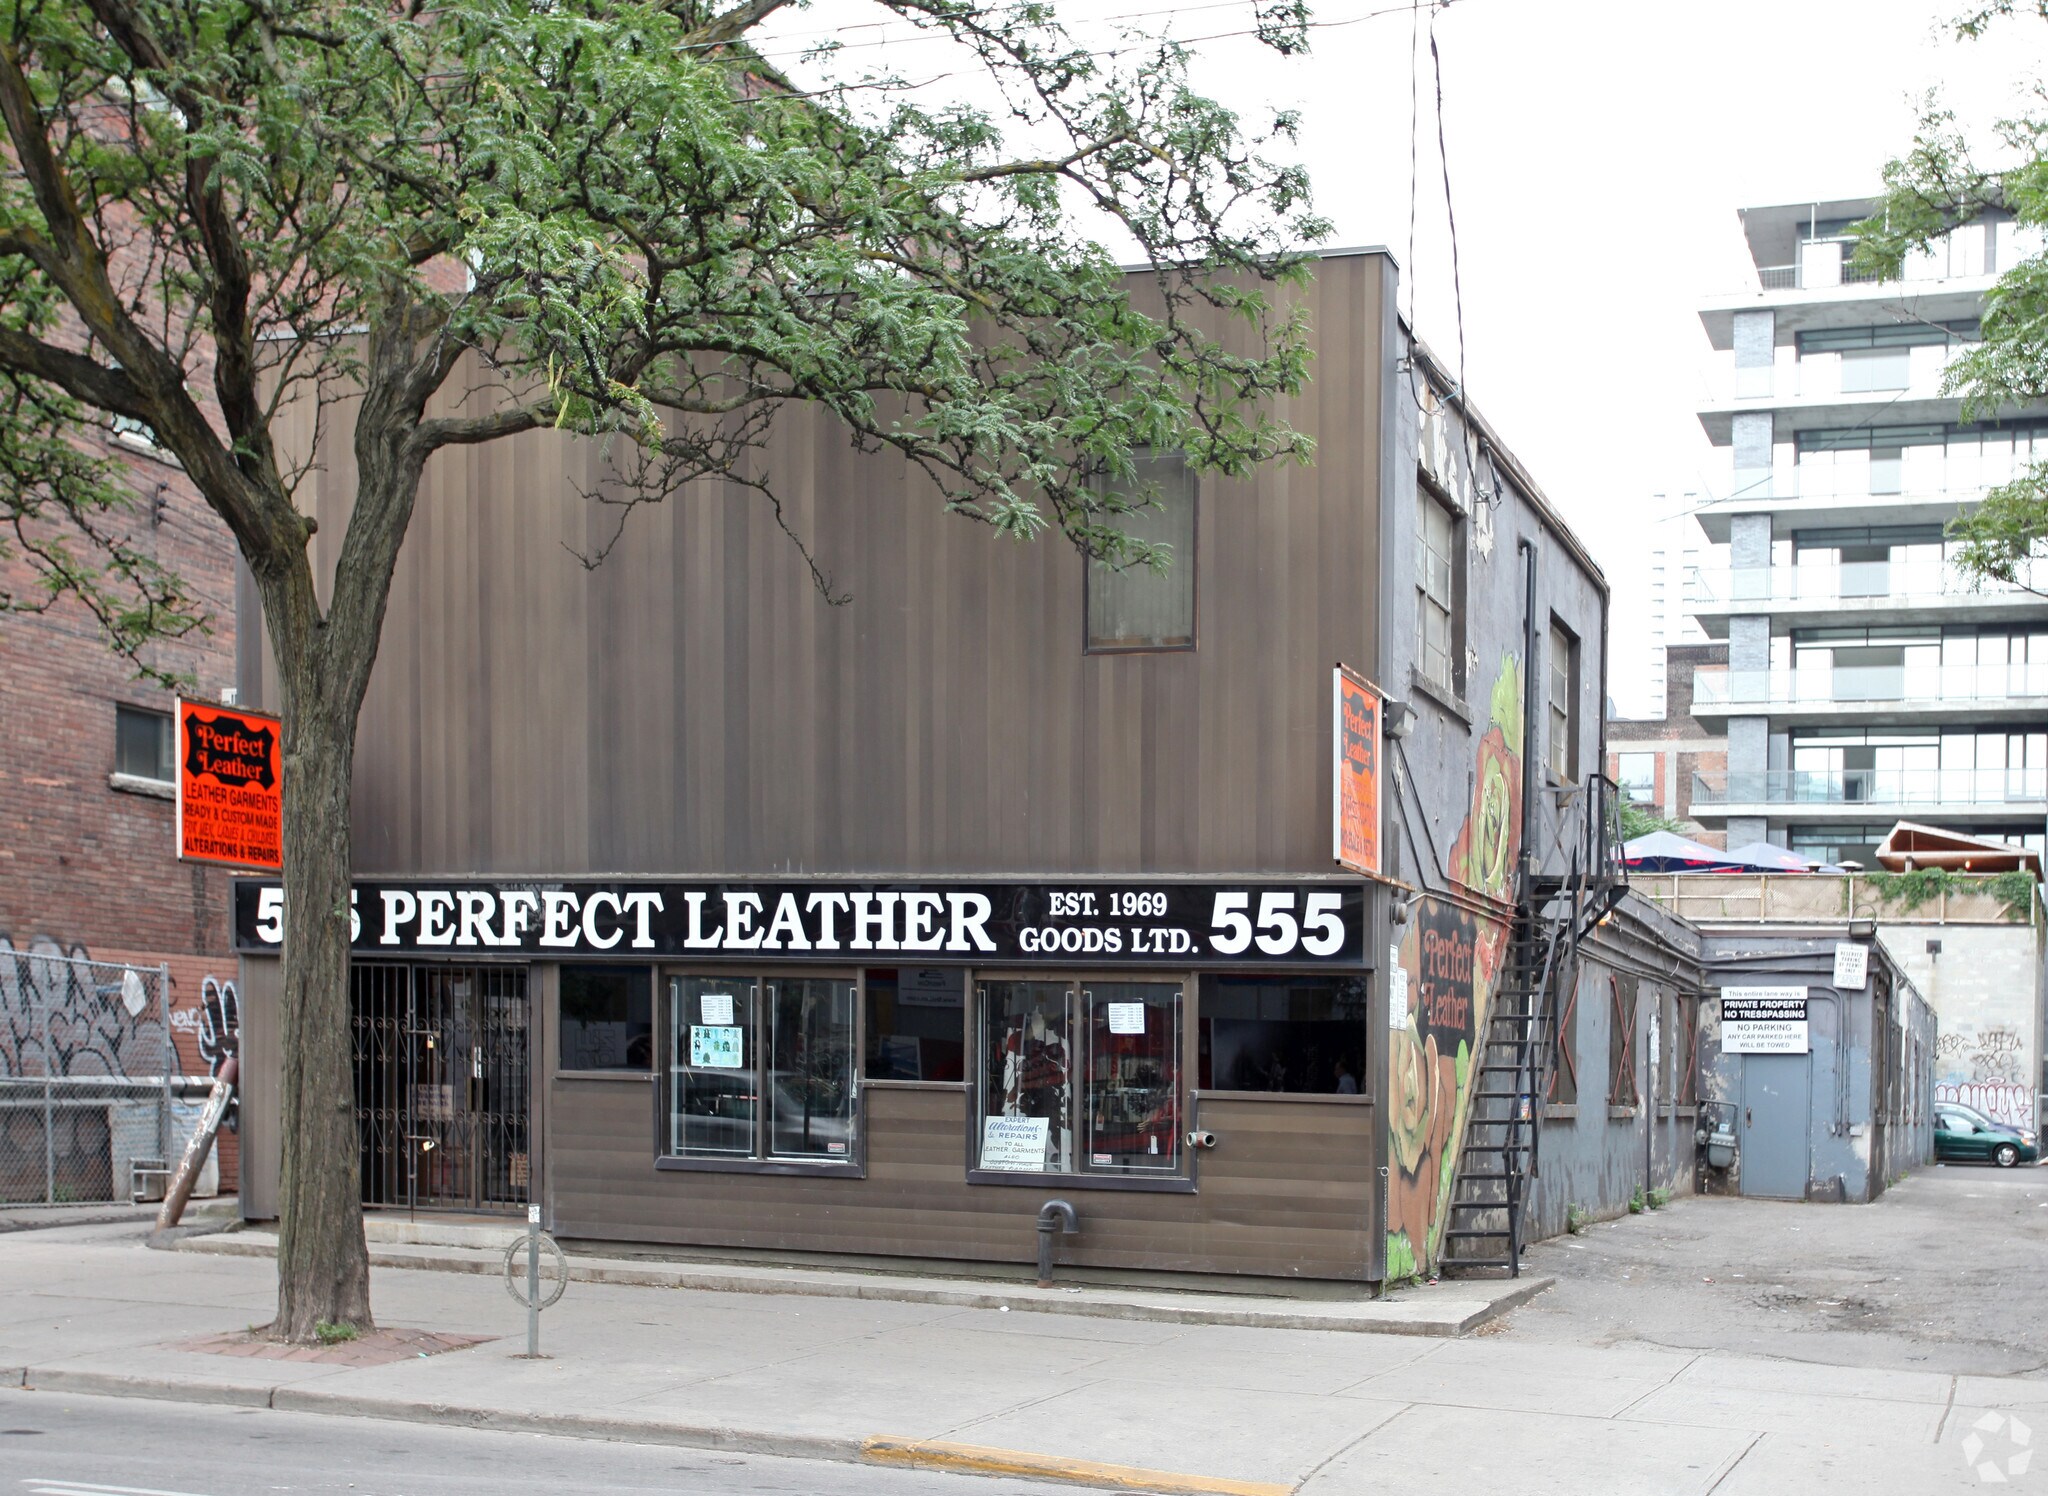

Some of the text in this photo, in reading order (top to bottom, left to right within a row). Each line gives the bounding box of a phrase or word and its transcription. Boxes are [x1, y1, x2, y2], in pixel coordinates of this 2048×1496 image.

[1343, 701, 1372, 741] Perfect
[195, 724, 265, 758] Perfect
[1343, 731, 1370, 767] Leather
[196, 750, 263, 780] Leather
[185, 781, 279, 814] LEATHER GARMENTS
[184, 802, 278, 830] READY & CUSTOM MADE
[185, 837, 279, 864] ALTERATIONS & REPAIRS
[1049, 892, 1168, 917] EST. 1969
[380, 889, 665, 950] PERFECT
[683, 891, 997, 952] LEATHER
[1208, 891, 1345, 956] 555
[1019, 927, 1199, 953] GOODS LTD.
[1424, 929, 1472, 984] Perfect
[1424, 982, 1468, 1030] Leather
[1724, 1000, 1806, 1009] PRIVATE PROPERTY
[1780, 991, 1793, 999] way
[1724, 1010, 1806, 1018] NO TRESSPASSING
[1737, 1023, 1792, 1031] NO PARKING
[998, 1132, 1038, 1141] REPAIRS
